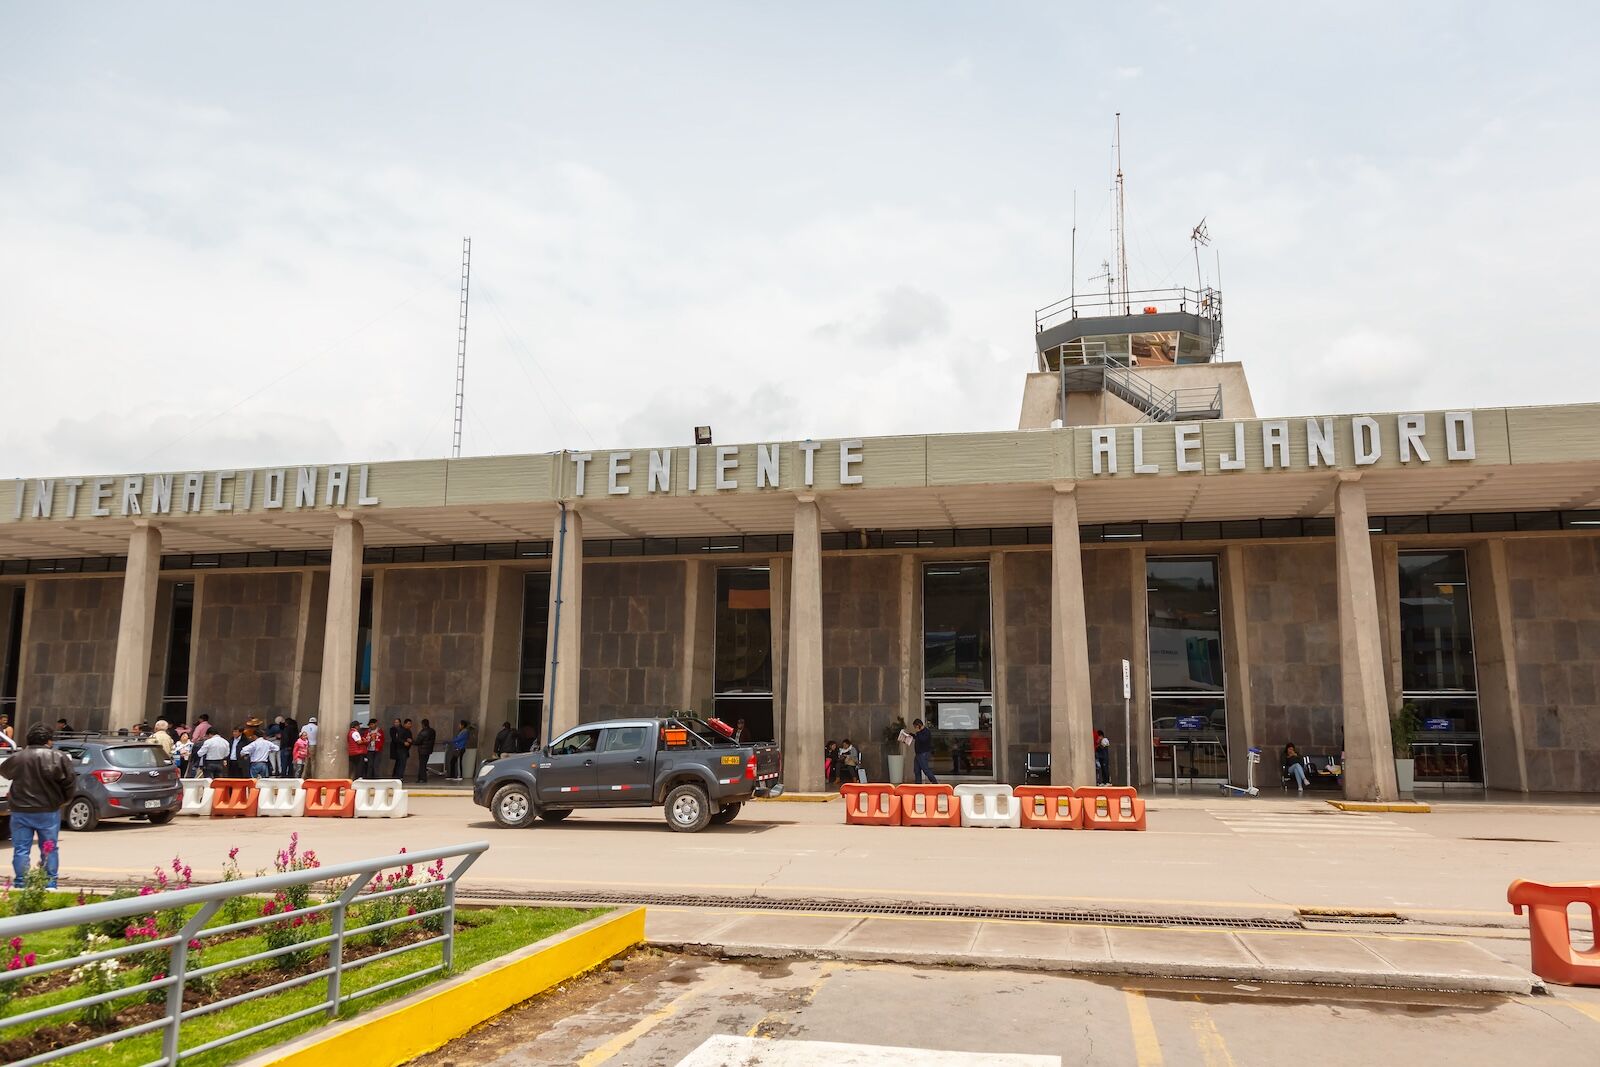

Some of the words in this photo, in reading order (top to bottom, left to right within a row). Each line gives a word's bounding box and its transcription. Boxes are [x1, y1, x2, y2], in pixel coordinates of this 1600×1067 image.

[14, 464, 382, 519] INTERNACIONAL
[571, 440, 863, 497] TENIENTE
[1091, 411, 1477, 474] ALEJANDRO
